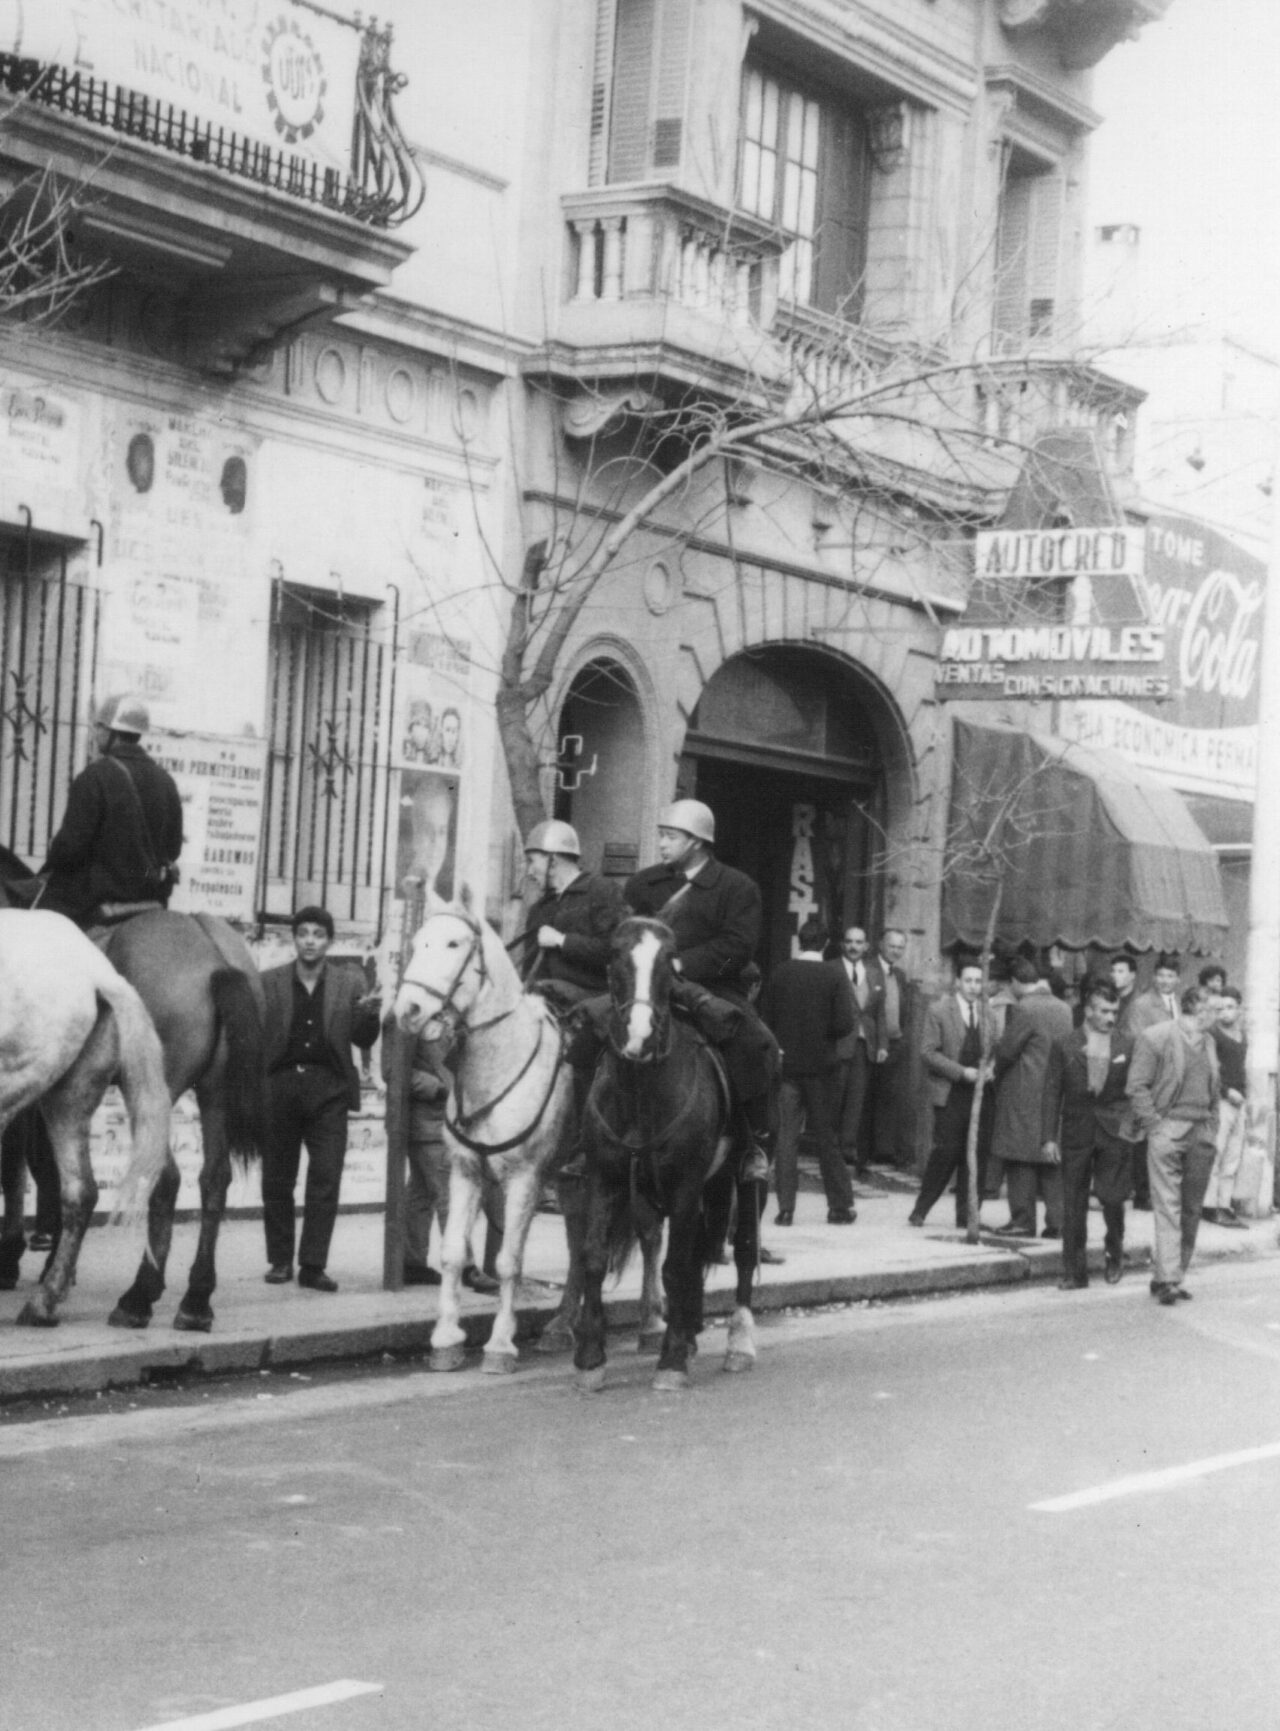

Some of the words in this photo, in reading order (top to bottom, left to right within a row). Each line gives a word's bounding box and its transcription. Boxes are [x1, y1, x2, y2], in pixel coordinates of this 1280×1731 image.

[986, 533, 1127, 573] AUTOCRED
[1150, 526, 1204, 567] TOME
[941, 627, 1165, 662] AUTOMOVILES
[935, 663, 1005, 684] VENTAS
